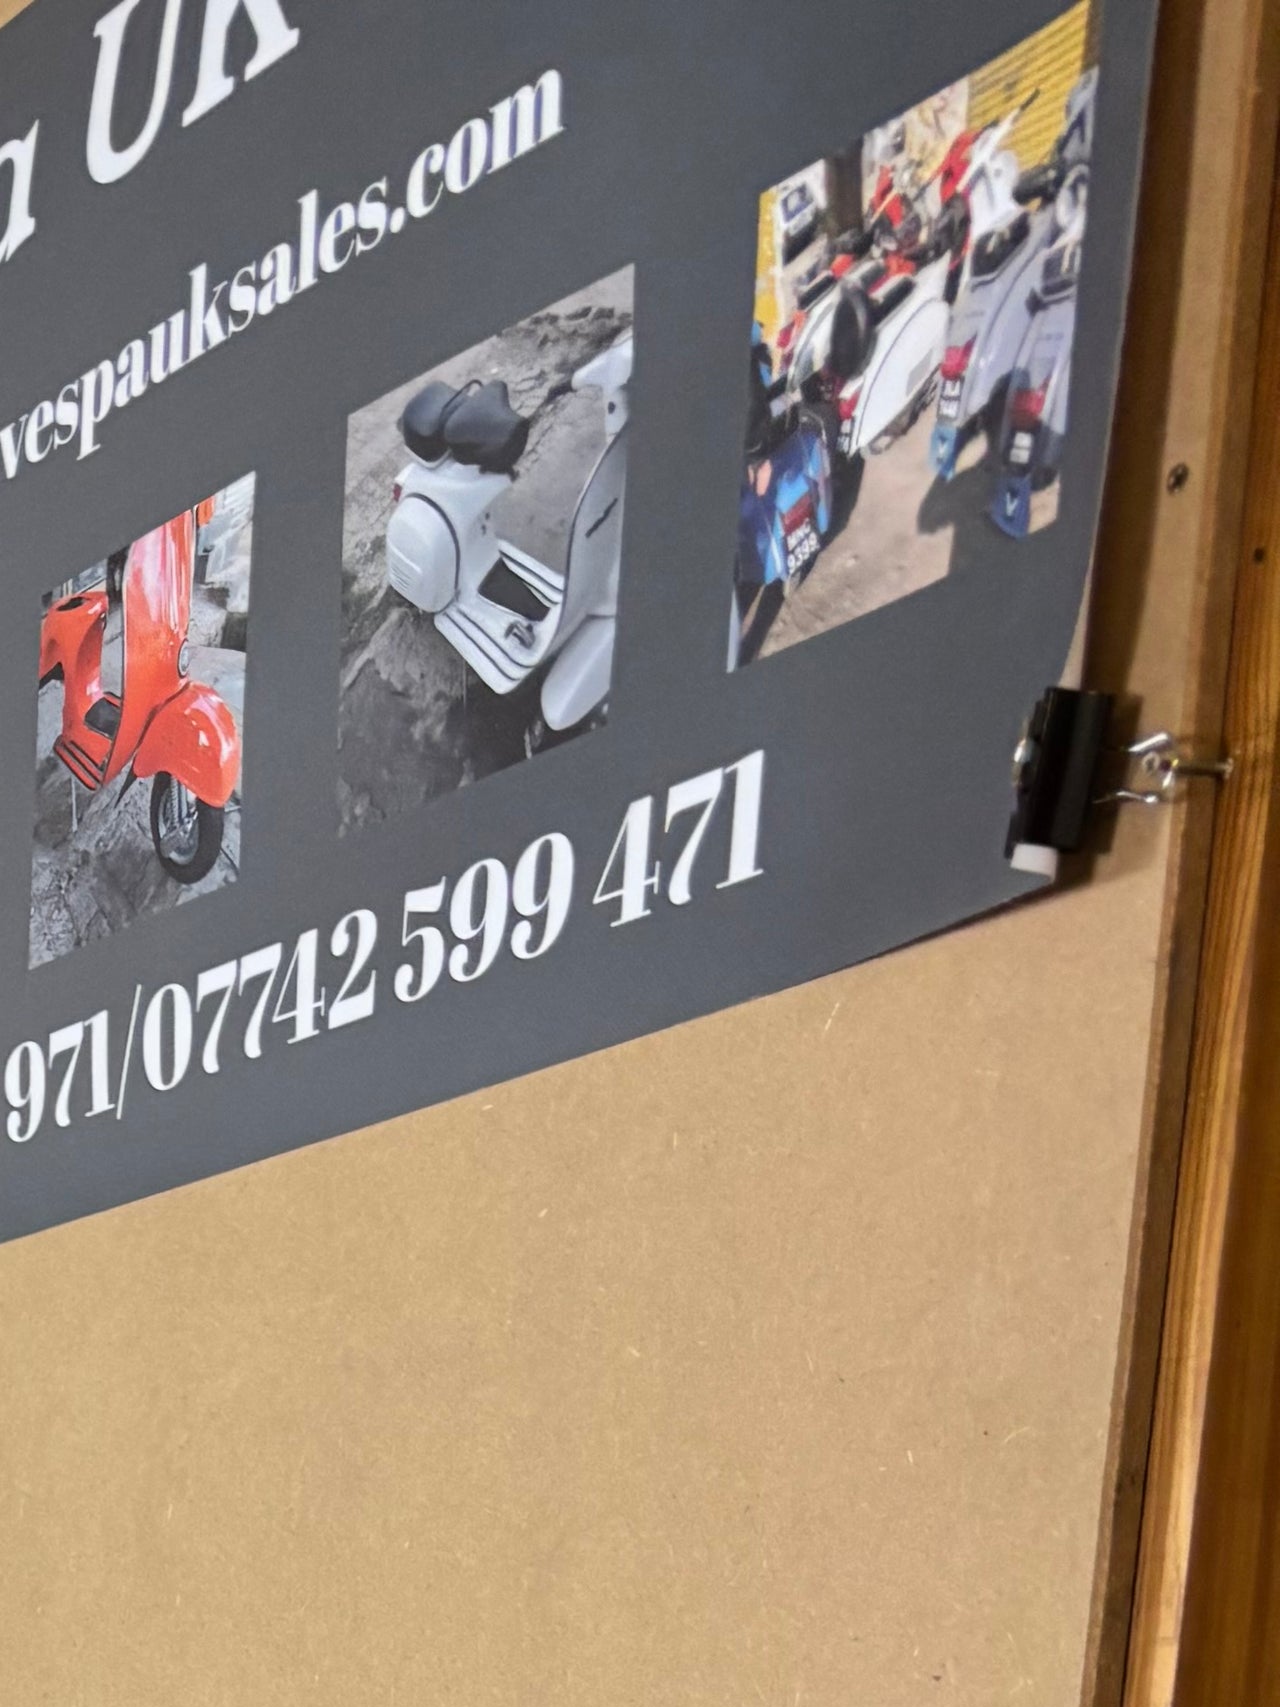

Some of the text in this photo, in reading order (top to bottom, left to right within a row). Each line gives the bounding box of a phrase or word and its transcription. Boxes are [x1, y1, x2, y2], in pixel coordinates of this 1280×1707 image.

[4, 908, 378, 1143] 971/07742
[394, 832, 575, 1003] 599
[592, 749, 765, 928] 471
